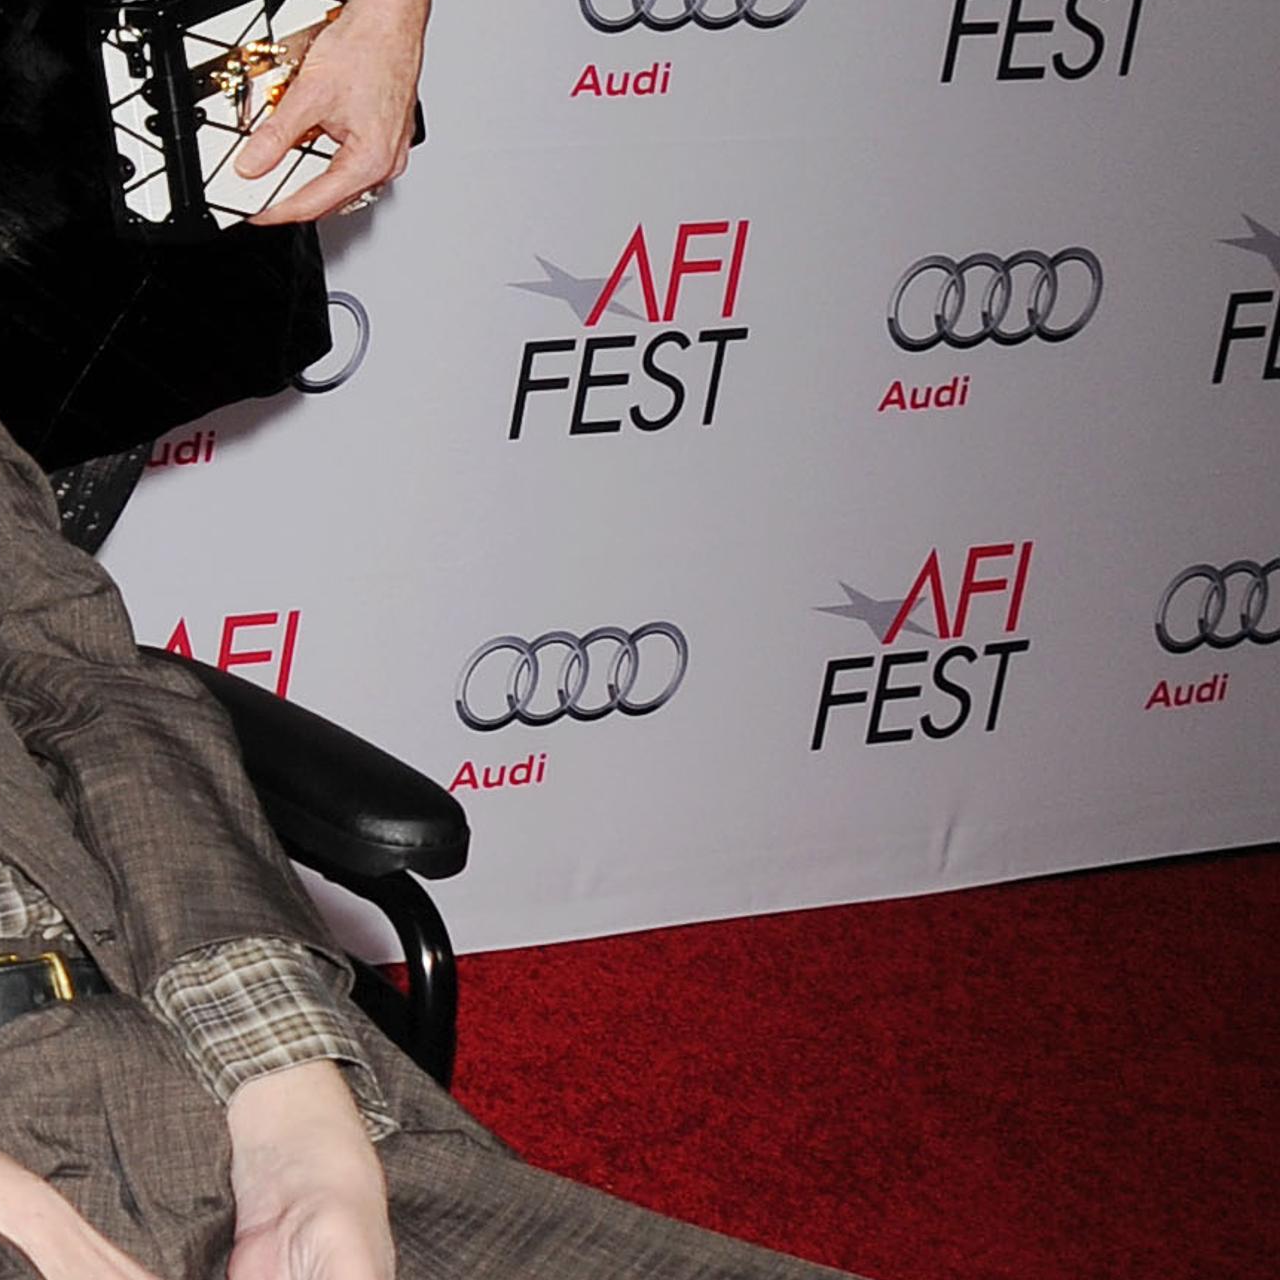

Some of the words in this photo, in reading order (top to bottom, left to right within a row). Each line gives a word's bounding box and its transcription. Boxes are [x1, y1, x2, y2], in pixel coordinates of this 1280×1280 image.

[570, 62, 672, 98] Audi
[584, 220, 750, 327] AFI
[509, 327, 749, 440] FEST
[877, 375, 971, 413] Audi
[146, 430, 216, 468] udi
[882, 542, 1034, 645] AFI
[811, 639, 1030, 751] FEST
[1144, 673, 1229, 711] Audi
[448, 754, 548, 794] Audi
